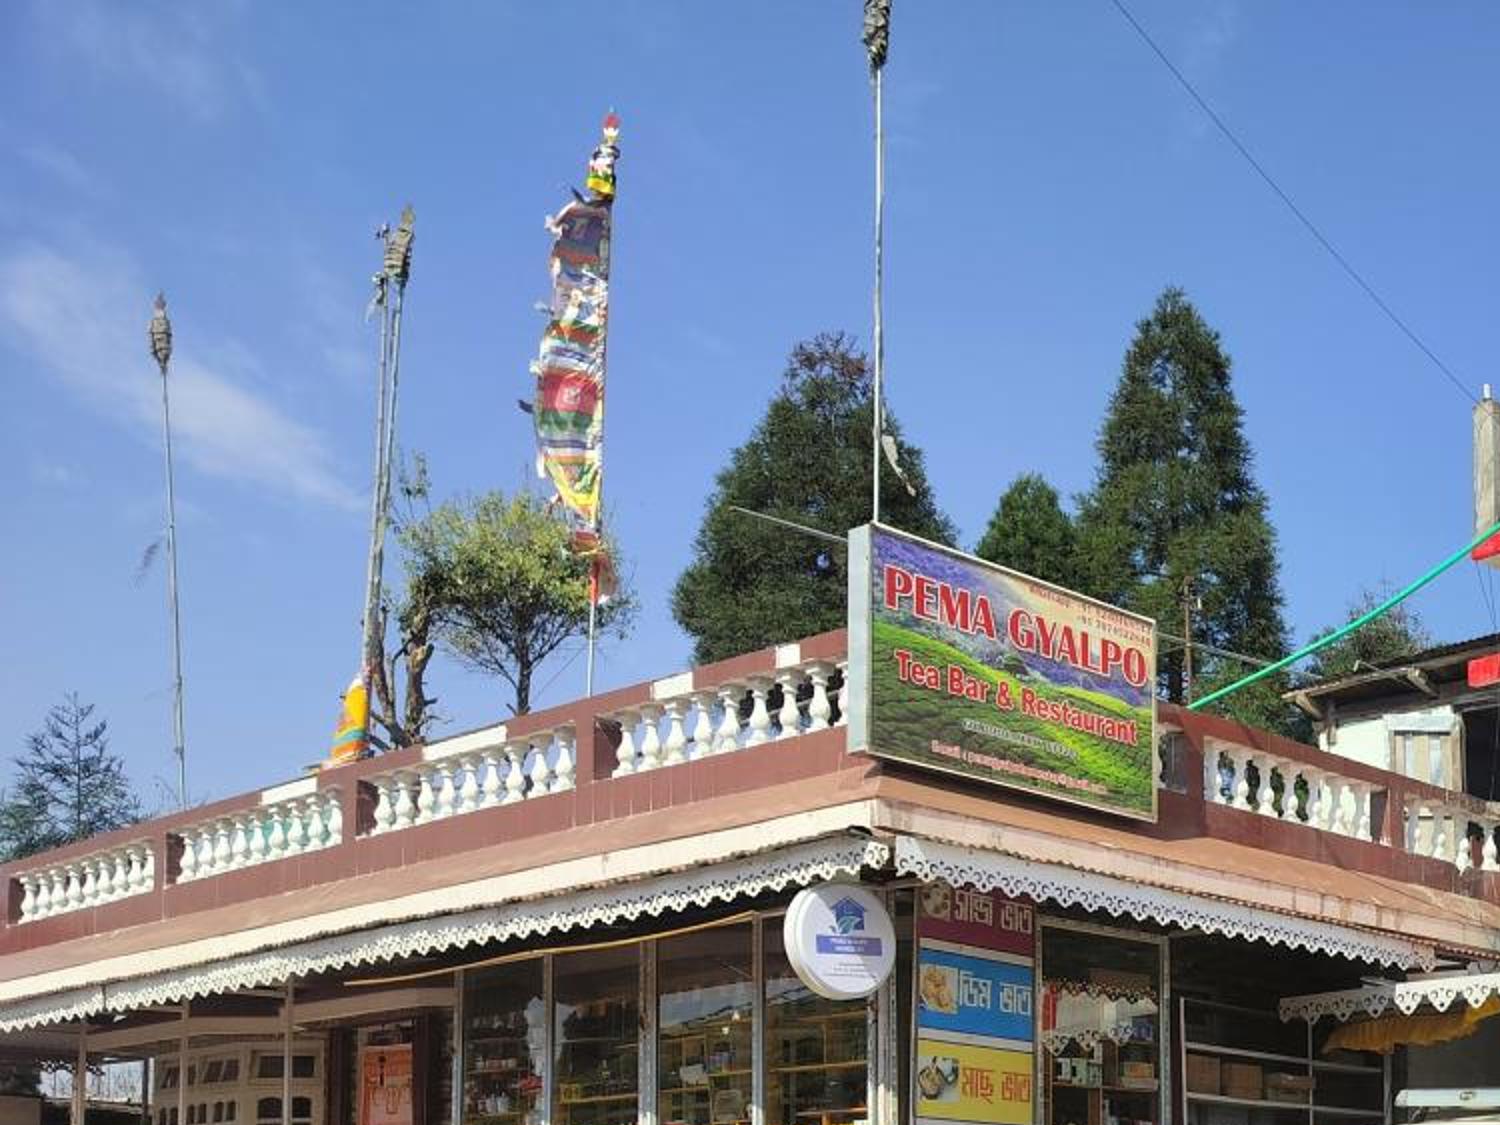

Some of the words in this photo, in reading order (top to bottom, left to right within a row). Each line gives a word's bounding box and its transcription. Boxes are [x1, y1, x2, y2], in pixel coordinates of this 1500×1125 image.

[884, 565, 996, 640] PEMA
[1008, 608, 1149, 687] GYALPO
[895, 650, 941, 690] Tea
[947, 667, 990, 703] Bar
[996, 681, 1014, 711] &
[1022, 687, 1138, 746] Restaurant
